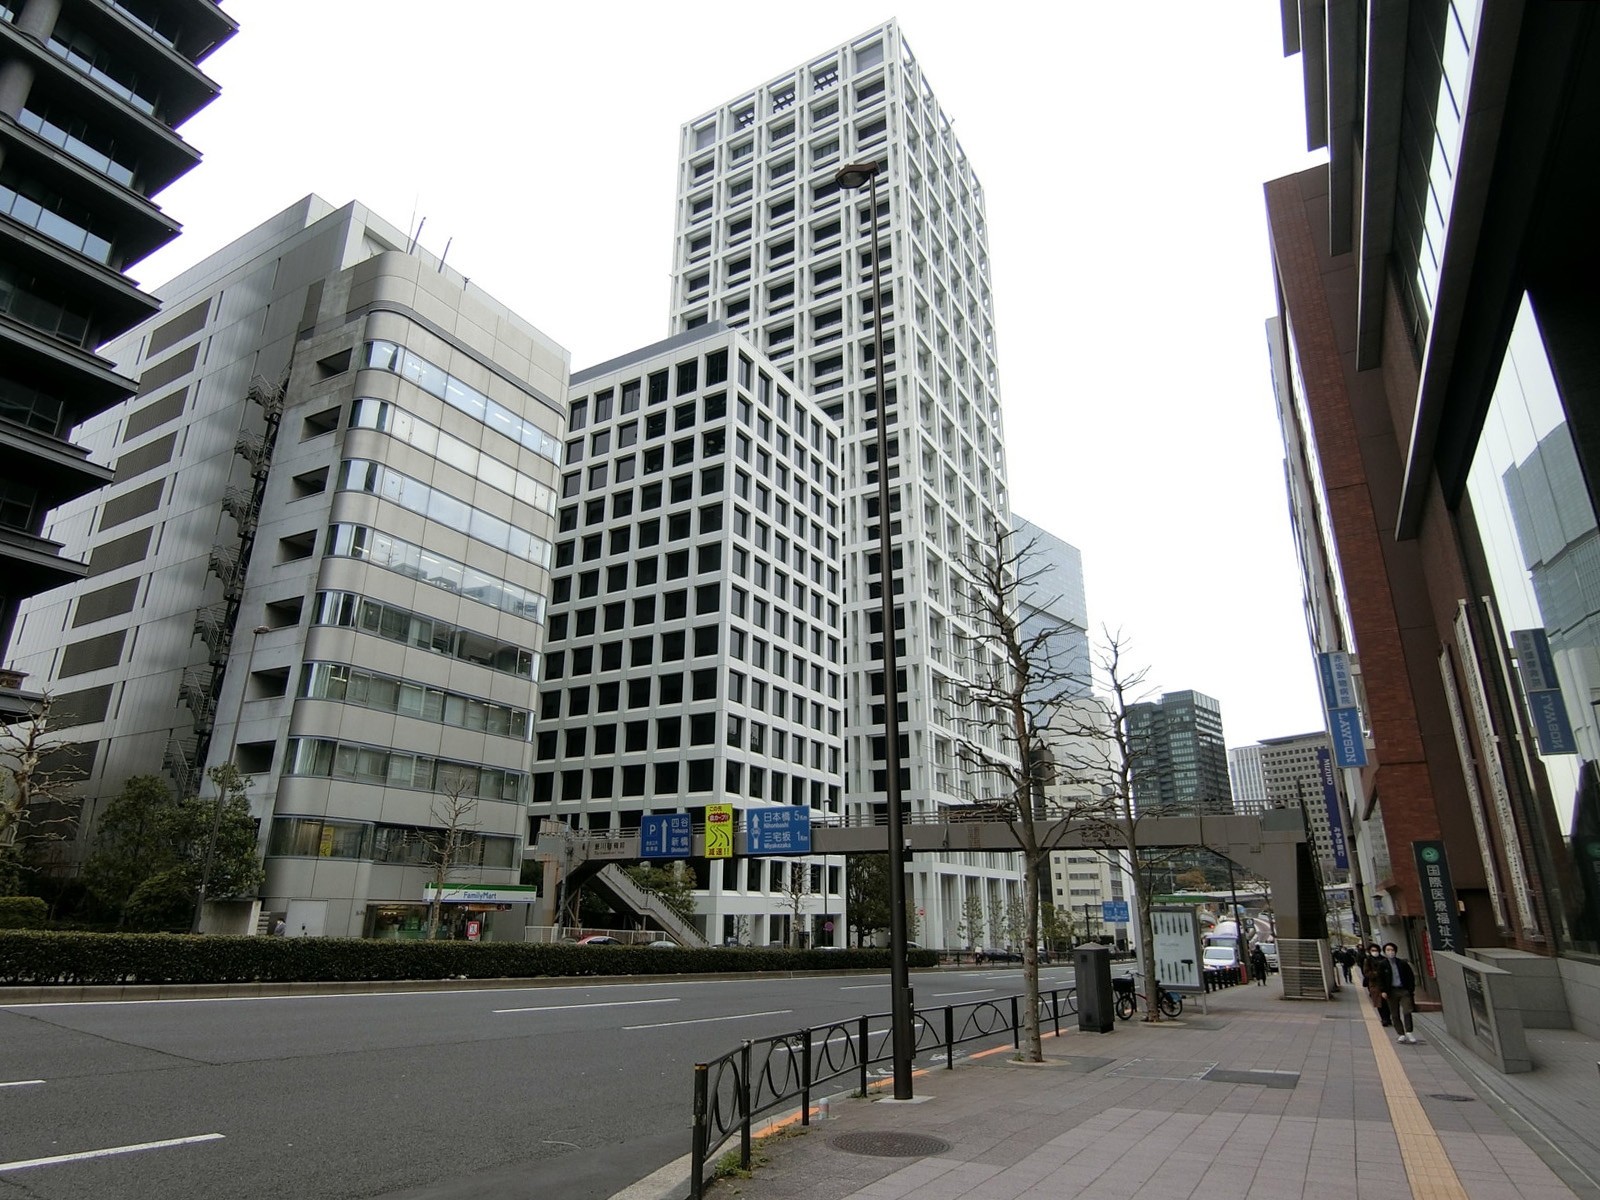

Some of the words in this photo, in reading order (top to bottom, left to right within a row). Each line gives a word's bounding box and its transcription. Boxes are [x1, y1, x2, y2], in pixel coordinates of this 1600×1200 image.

[1337, 711, 1358, 764] LAWSON
[1323, 758, 1334, 786] MIZUHO
[671, 817, 689, 828] 四谷
[763, 811, 791, 823] 日本橋
[764, 831, 791, 842] 三宅坂
[463, 891, 497, 900] FamilyMart
[1426, 864, 1456, 953] 国際医療福祉大
